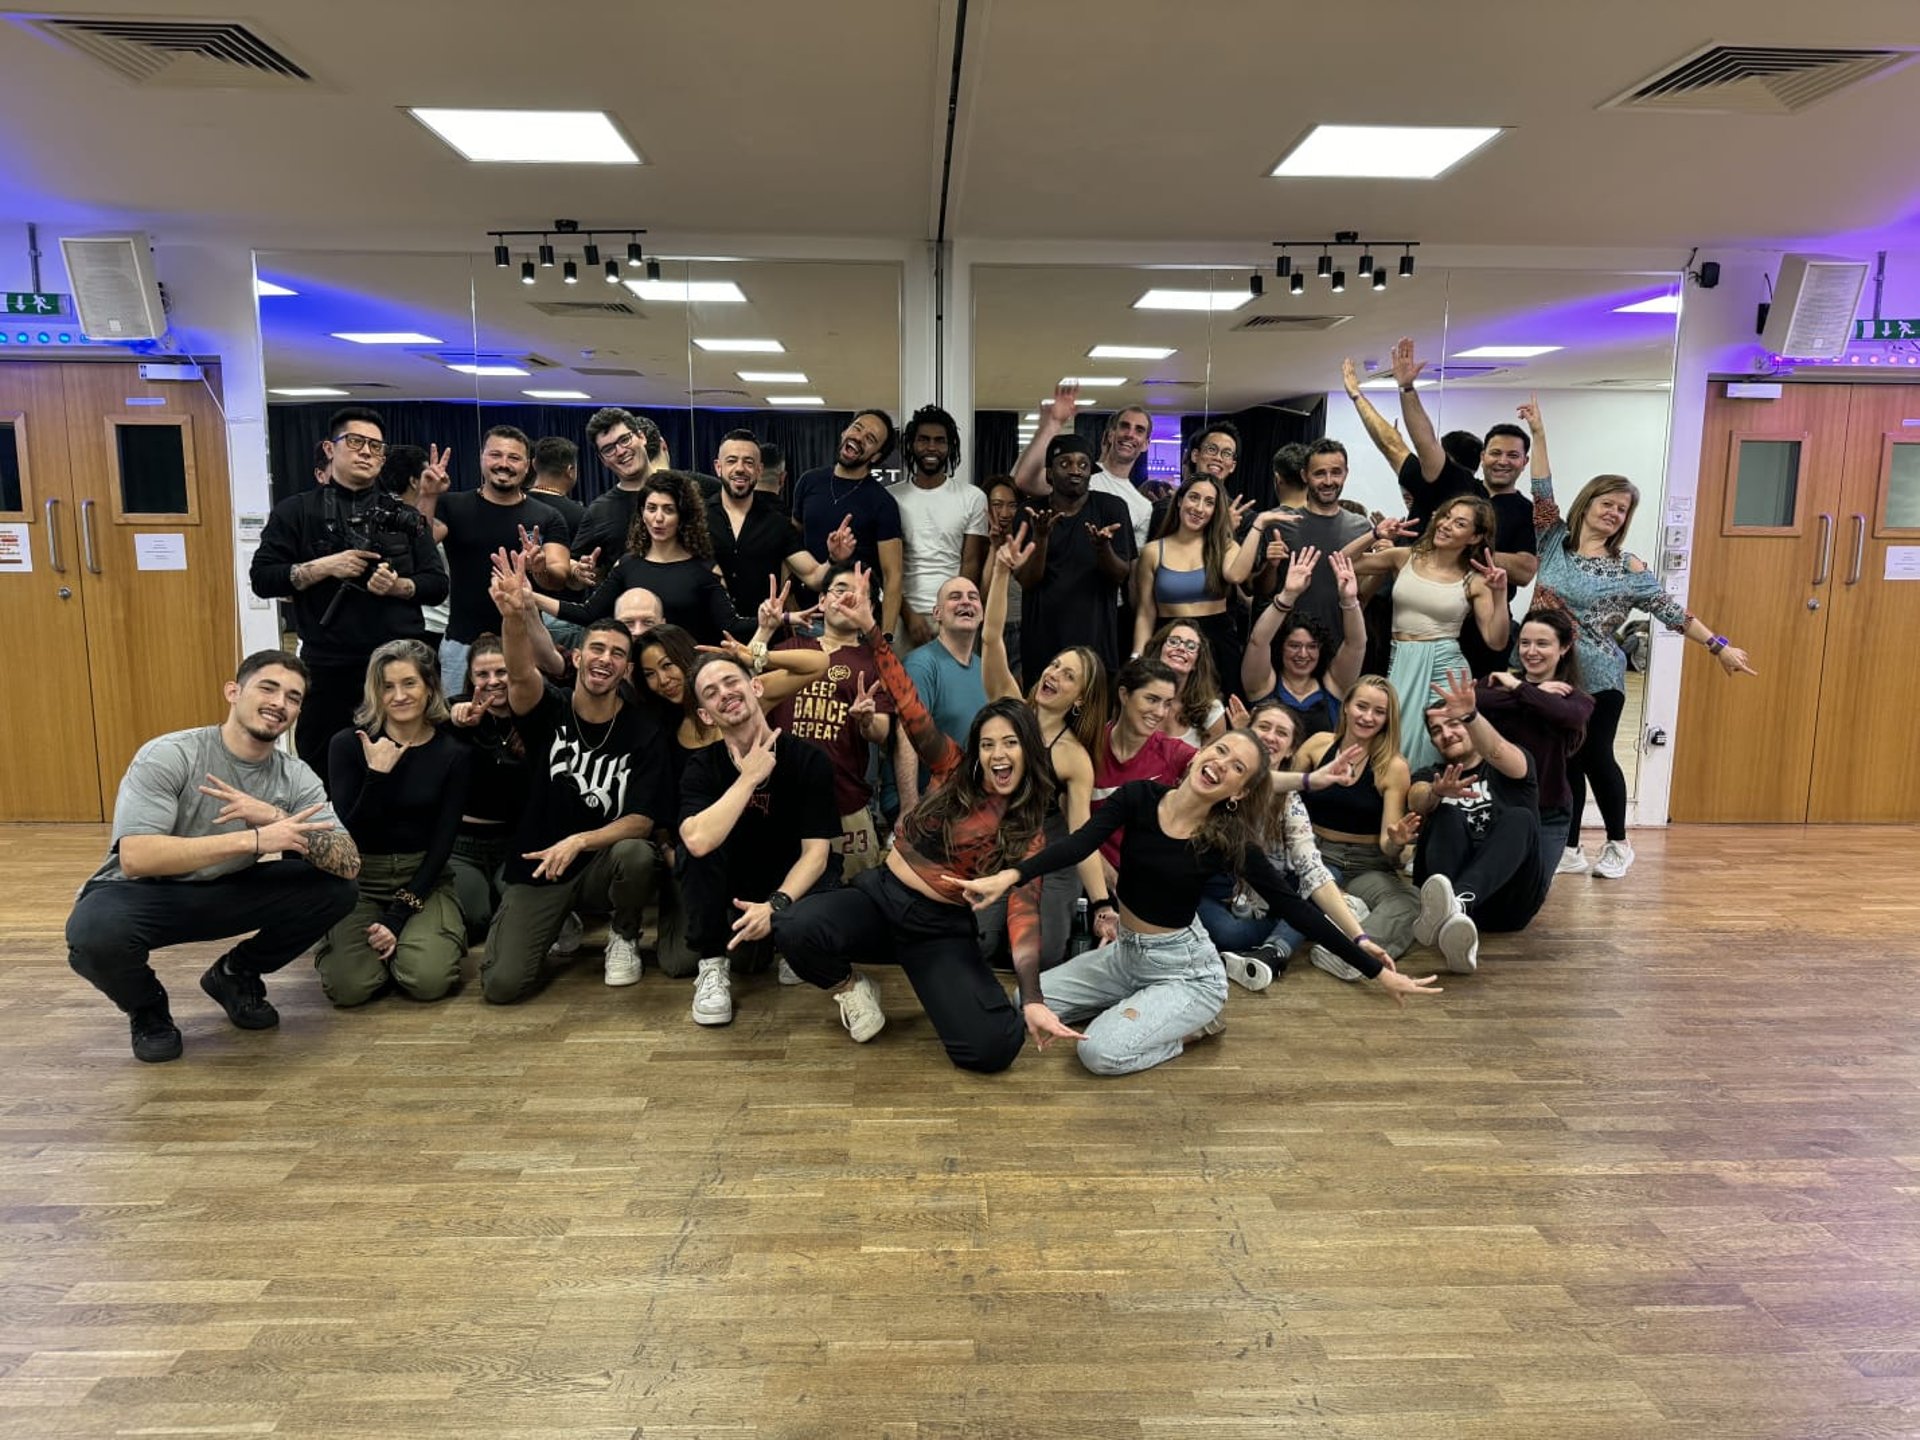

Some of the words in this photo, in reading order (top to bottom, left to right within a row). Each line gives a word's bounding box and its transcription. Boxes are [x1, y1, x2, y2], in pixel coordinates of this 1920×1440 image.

[797, 680, 837, 698] LEEP
[793, 695, 849, 725] DANCE
[791, 721, 841, 741] REPEAT
[842, 829, 868, 855] 23
